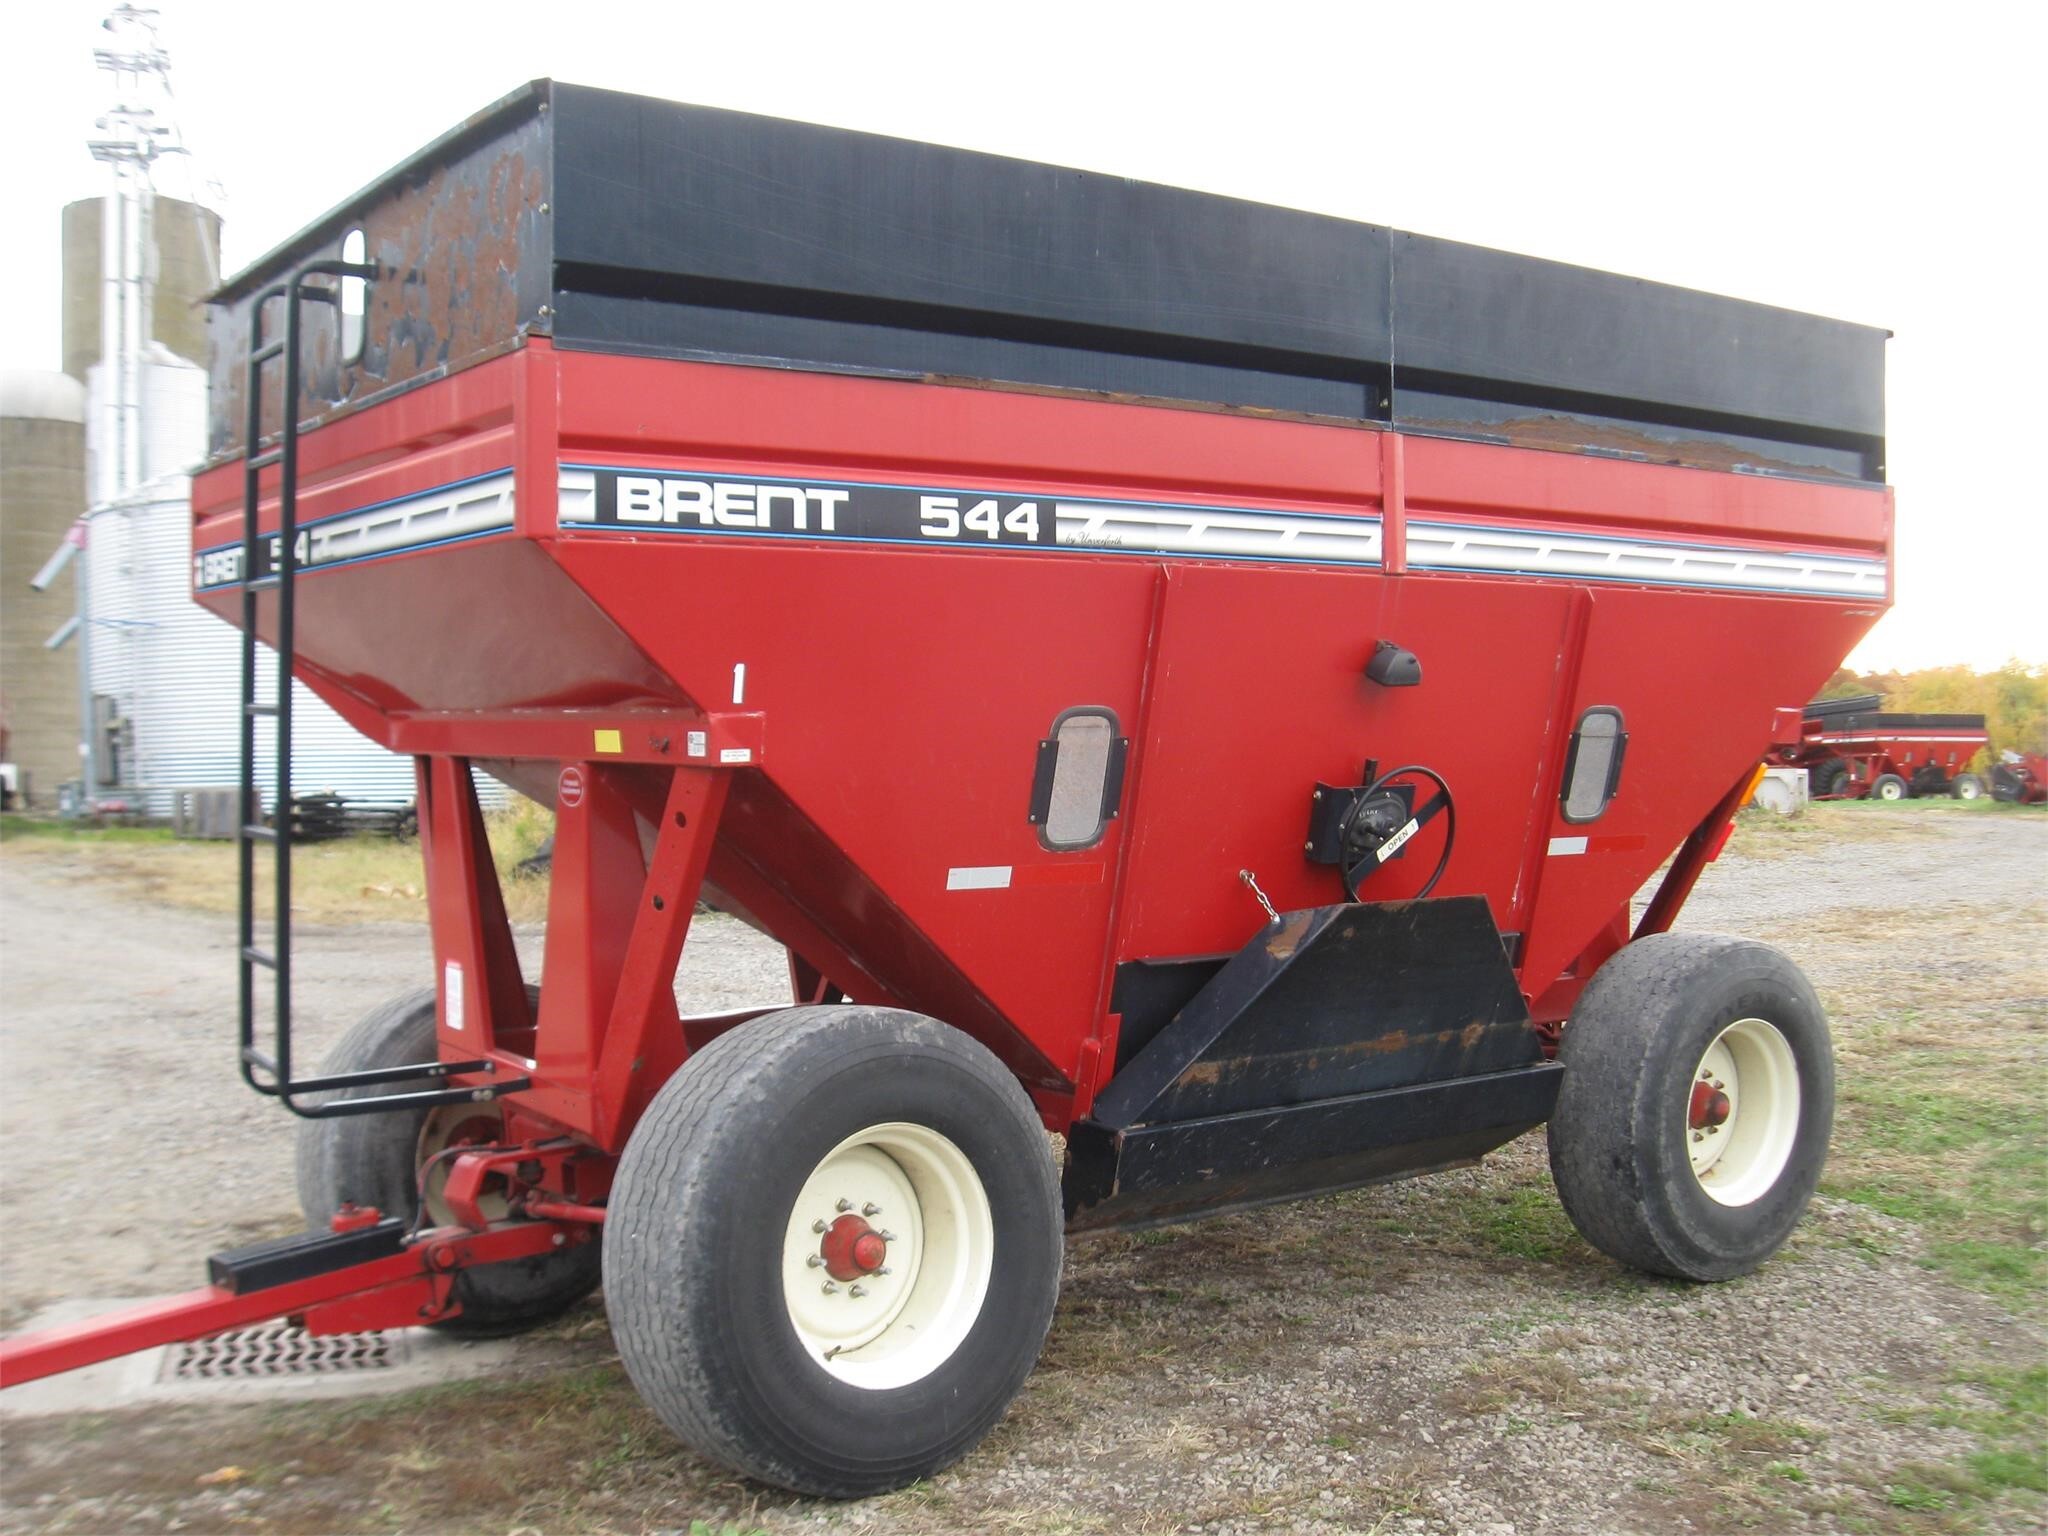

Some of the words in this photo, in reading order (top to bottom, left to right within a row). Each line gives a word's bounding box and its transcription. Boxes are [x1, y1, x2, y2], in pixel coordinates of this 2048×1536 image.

[616, 476, 850, 531] BRENT
[919, 495, 1040, 542] 544
[269, 528, 309, 573] 54
[732, 662, 746, 704] 1
[1387, 828, 1409, 851] OPEN
